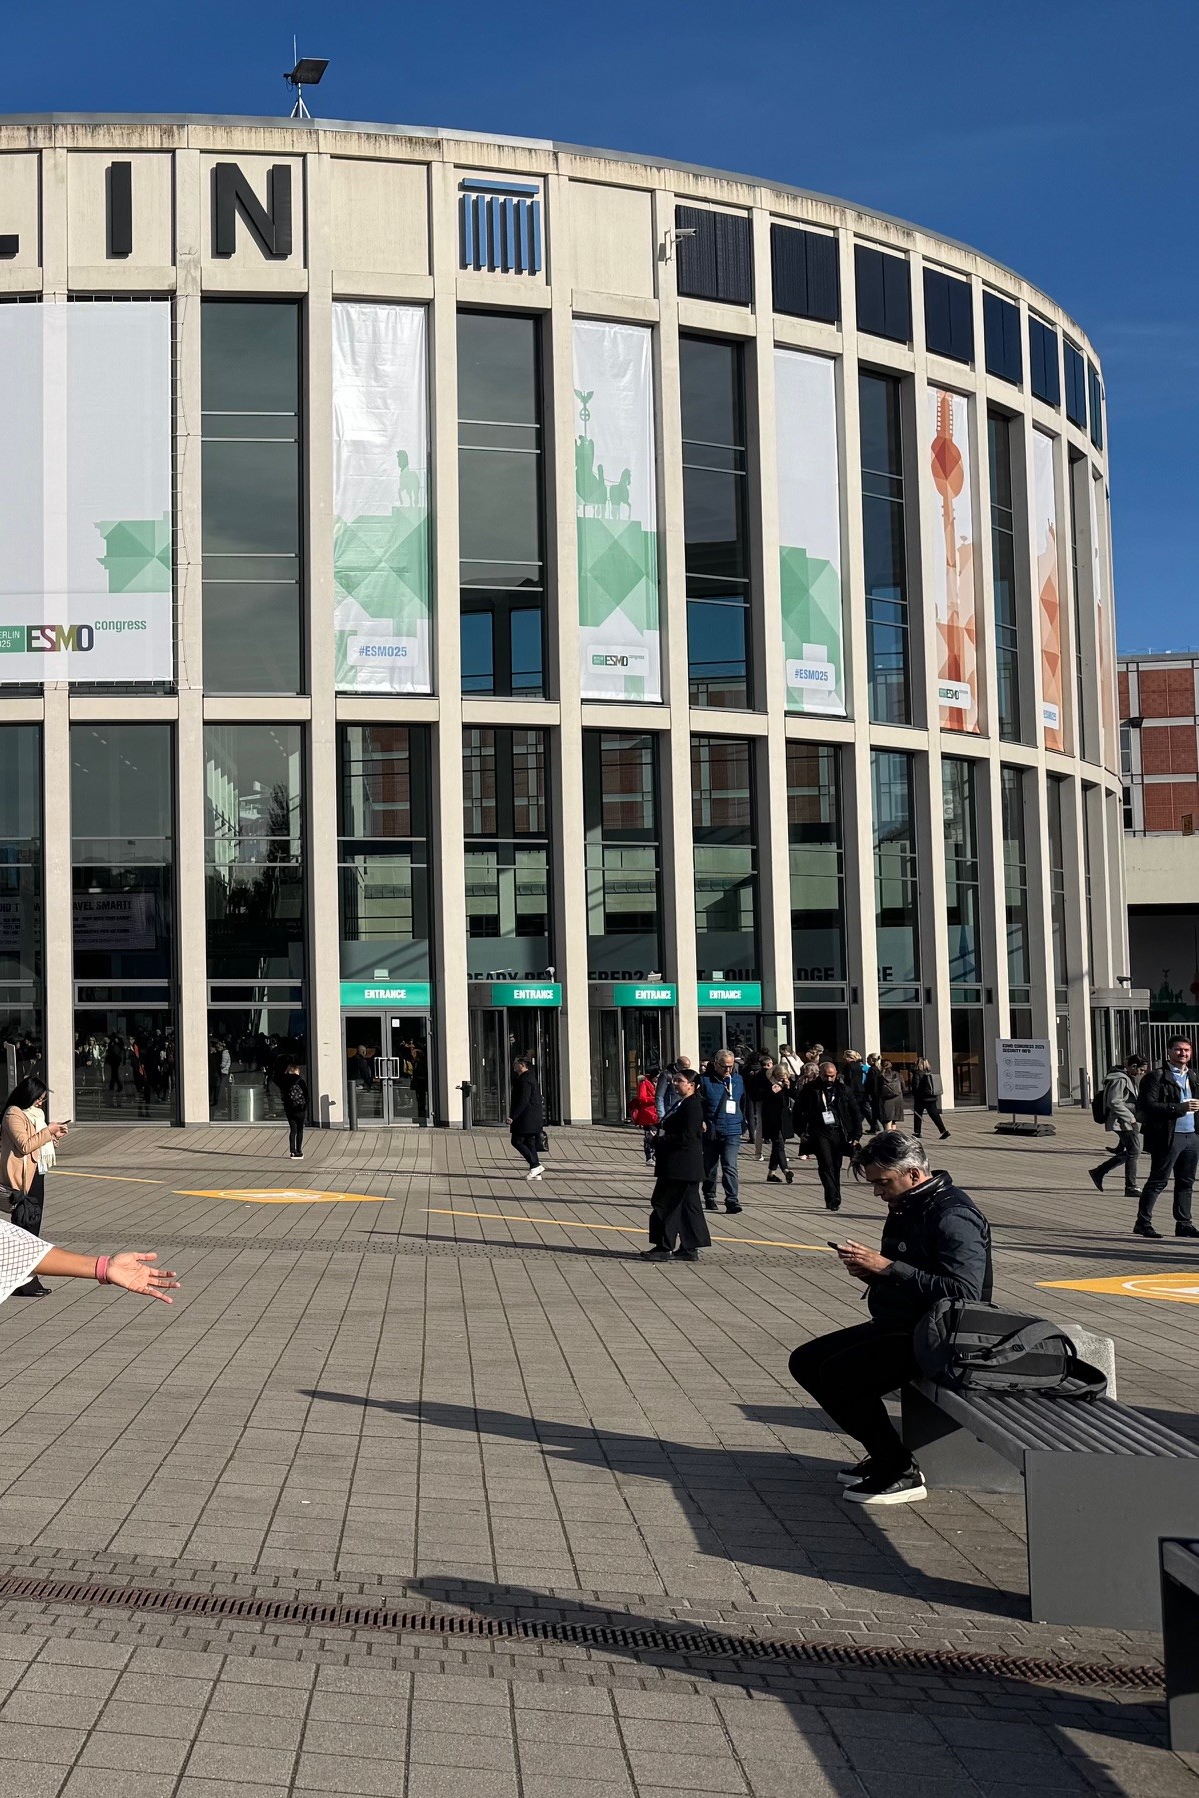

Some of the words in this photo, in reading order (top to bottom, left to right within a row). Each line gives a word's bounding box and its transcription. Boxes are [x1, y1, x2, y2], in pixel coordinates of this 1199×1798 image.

[26, 624, 95, 653] ESMO
[94, 619, 147, 633] congress
[364, 989, 407, 999] ENTRANCE
[513, 989, 554, 1000] ENTRANCE
[635, 989, 672, 1000] ENTRANCE
[709, 989, 742, 999] ENTRANCE
